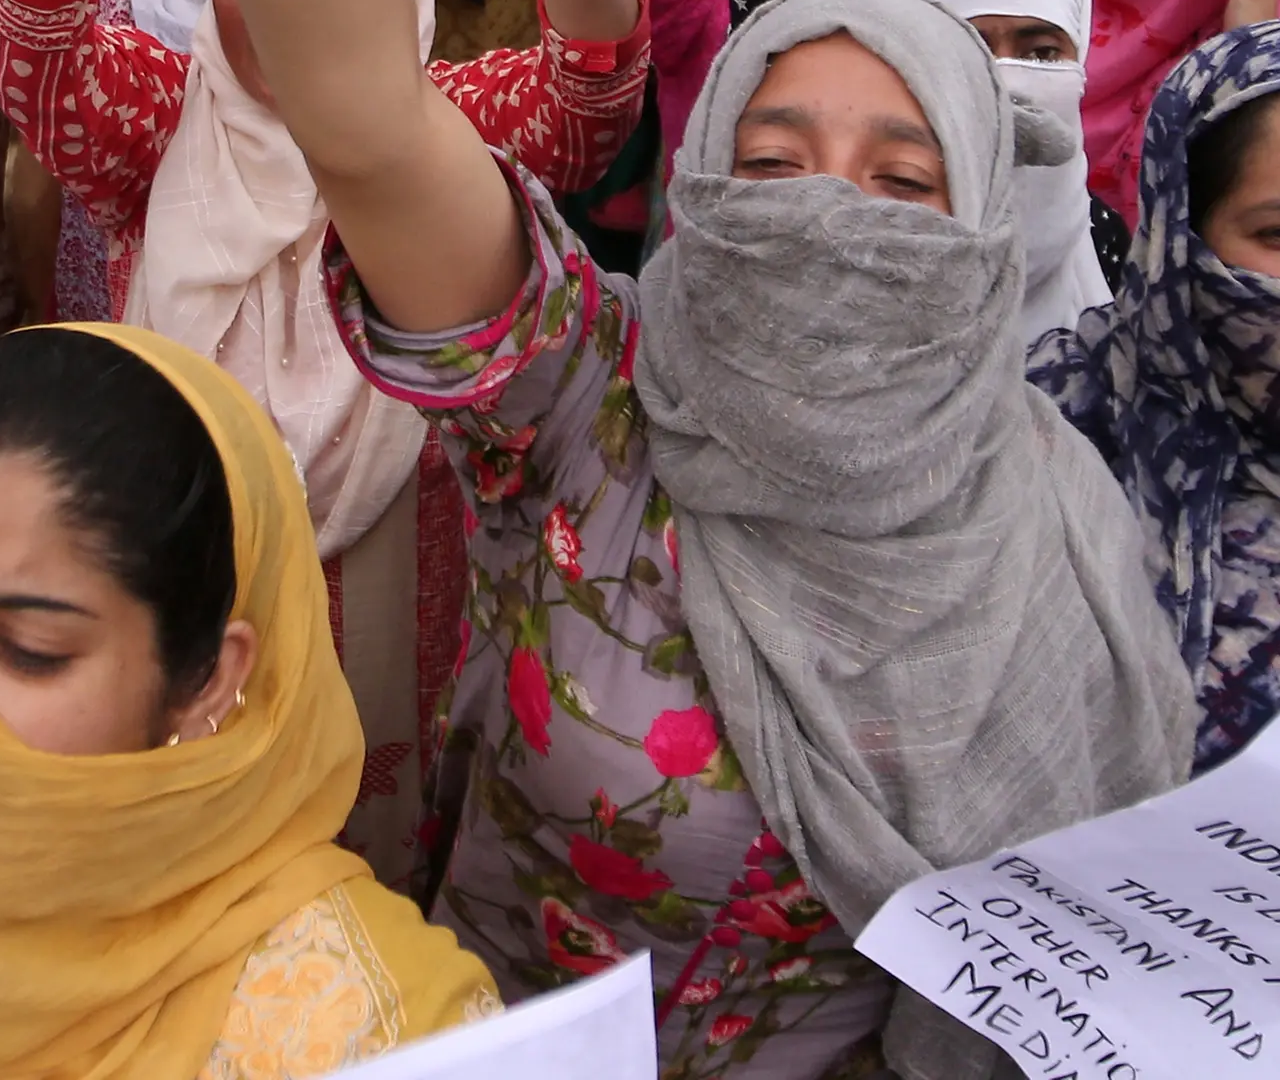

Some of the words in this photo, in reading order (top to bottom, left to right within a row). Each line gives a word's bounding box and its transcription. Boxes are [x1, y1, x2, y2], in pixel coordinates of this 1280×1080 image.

[1106, 878, 1272, 967] THANKS
[1212, 886, 1269, 905] IS
[981, 897, 1110, 989] OTHER
